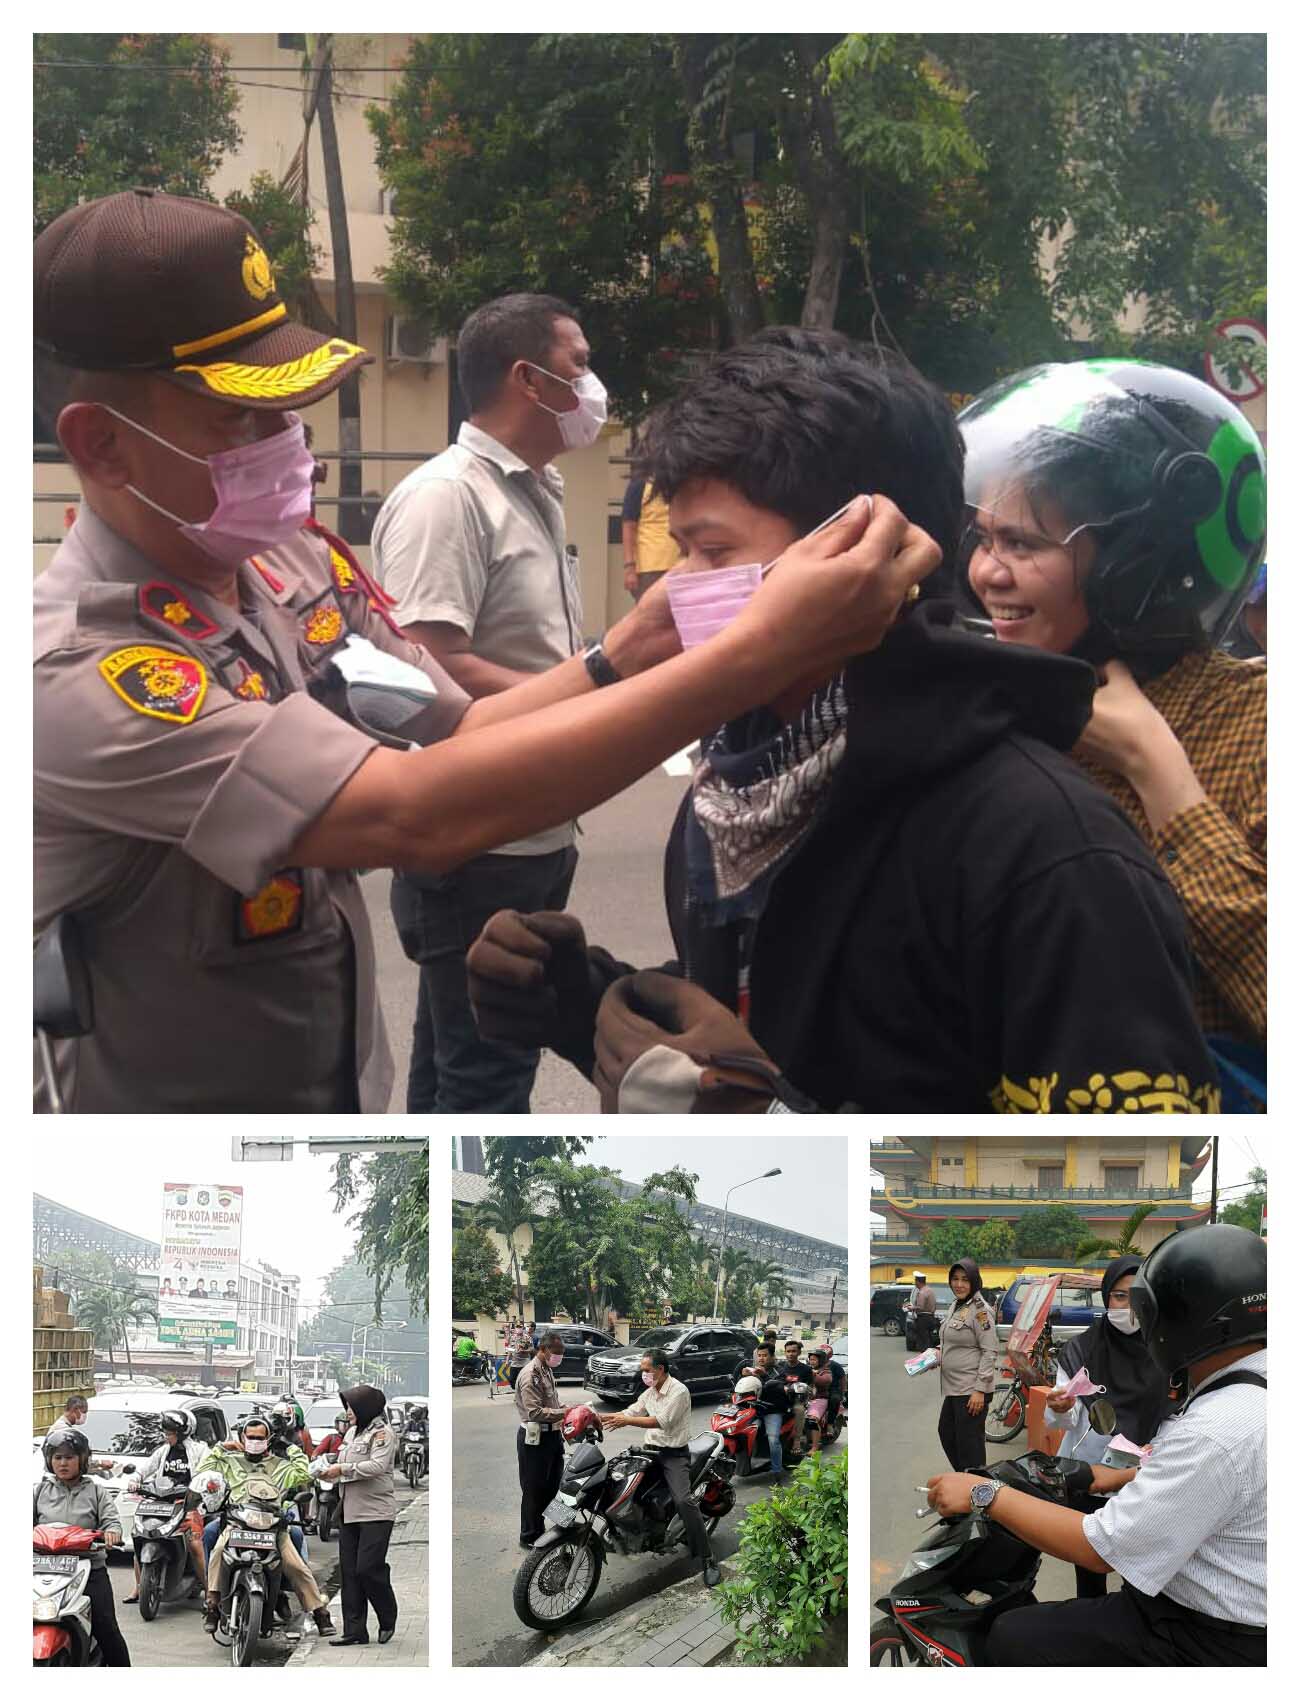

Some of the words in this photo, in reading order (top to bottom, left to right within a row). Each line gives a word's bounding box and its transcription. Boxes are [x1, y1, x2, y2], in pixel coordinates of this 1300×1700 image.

[165, 1208, 187, 1221] FKPD
[189, 1209, 210, 1223] KOTA
[212, 1211, 241, 1224] MEDAN
[164, 1244, 197, 1255] REPUBLIK
[198, 1247, 238, 1257] INDONESIA
[895, 1599, 921, 1607] HONDA
